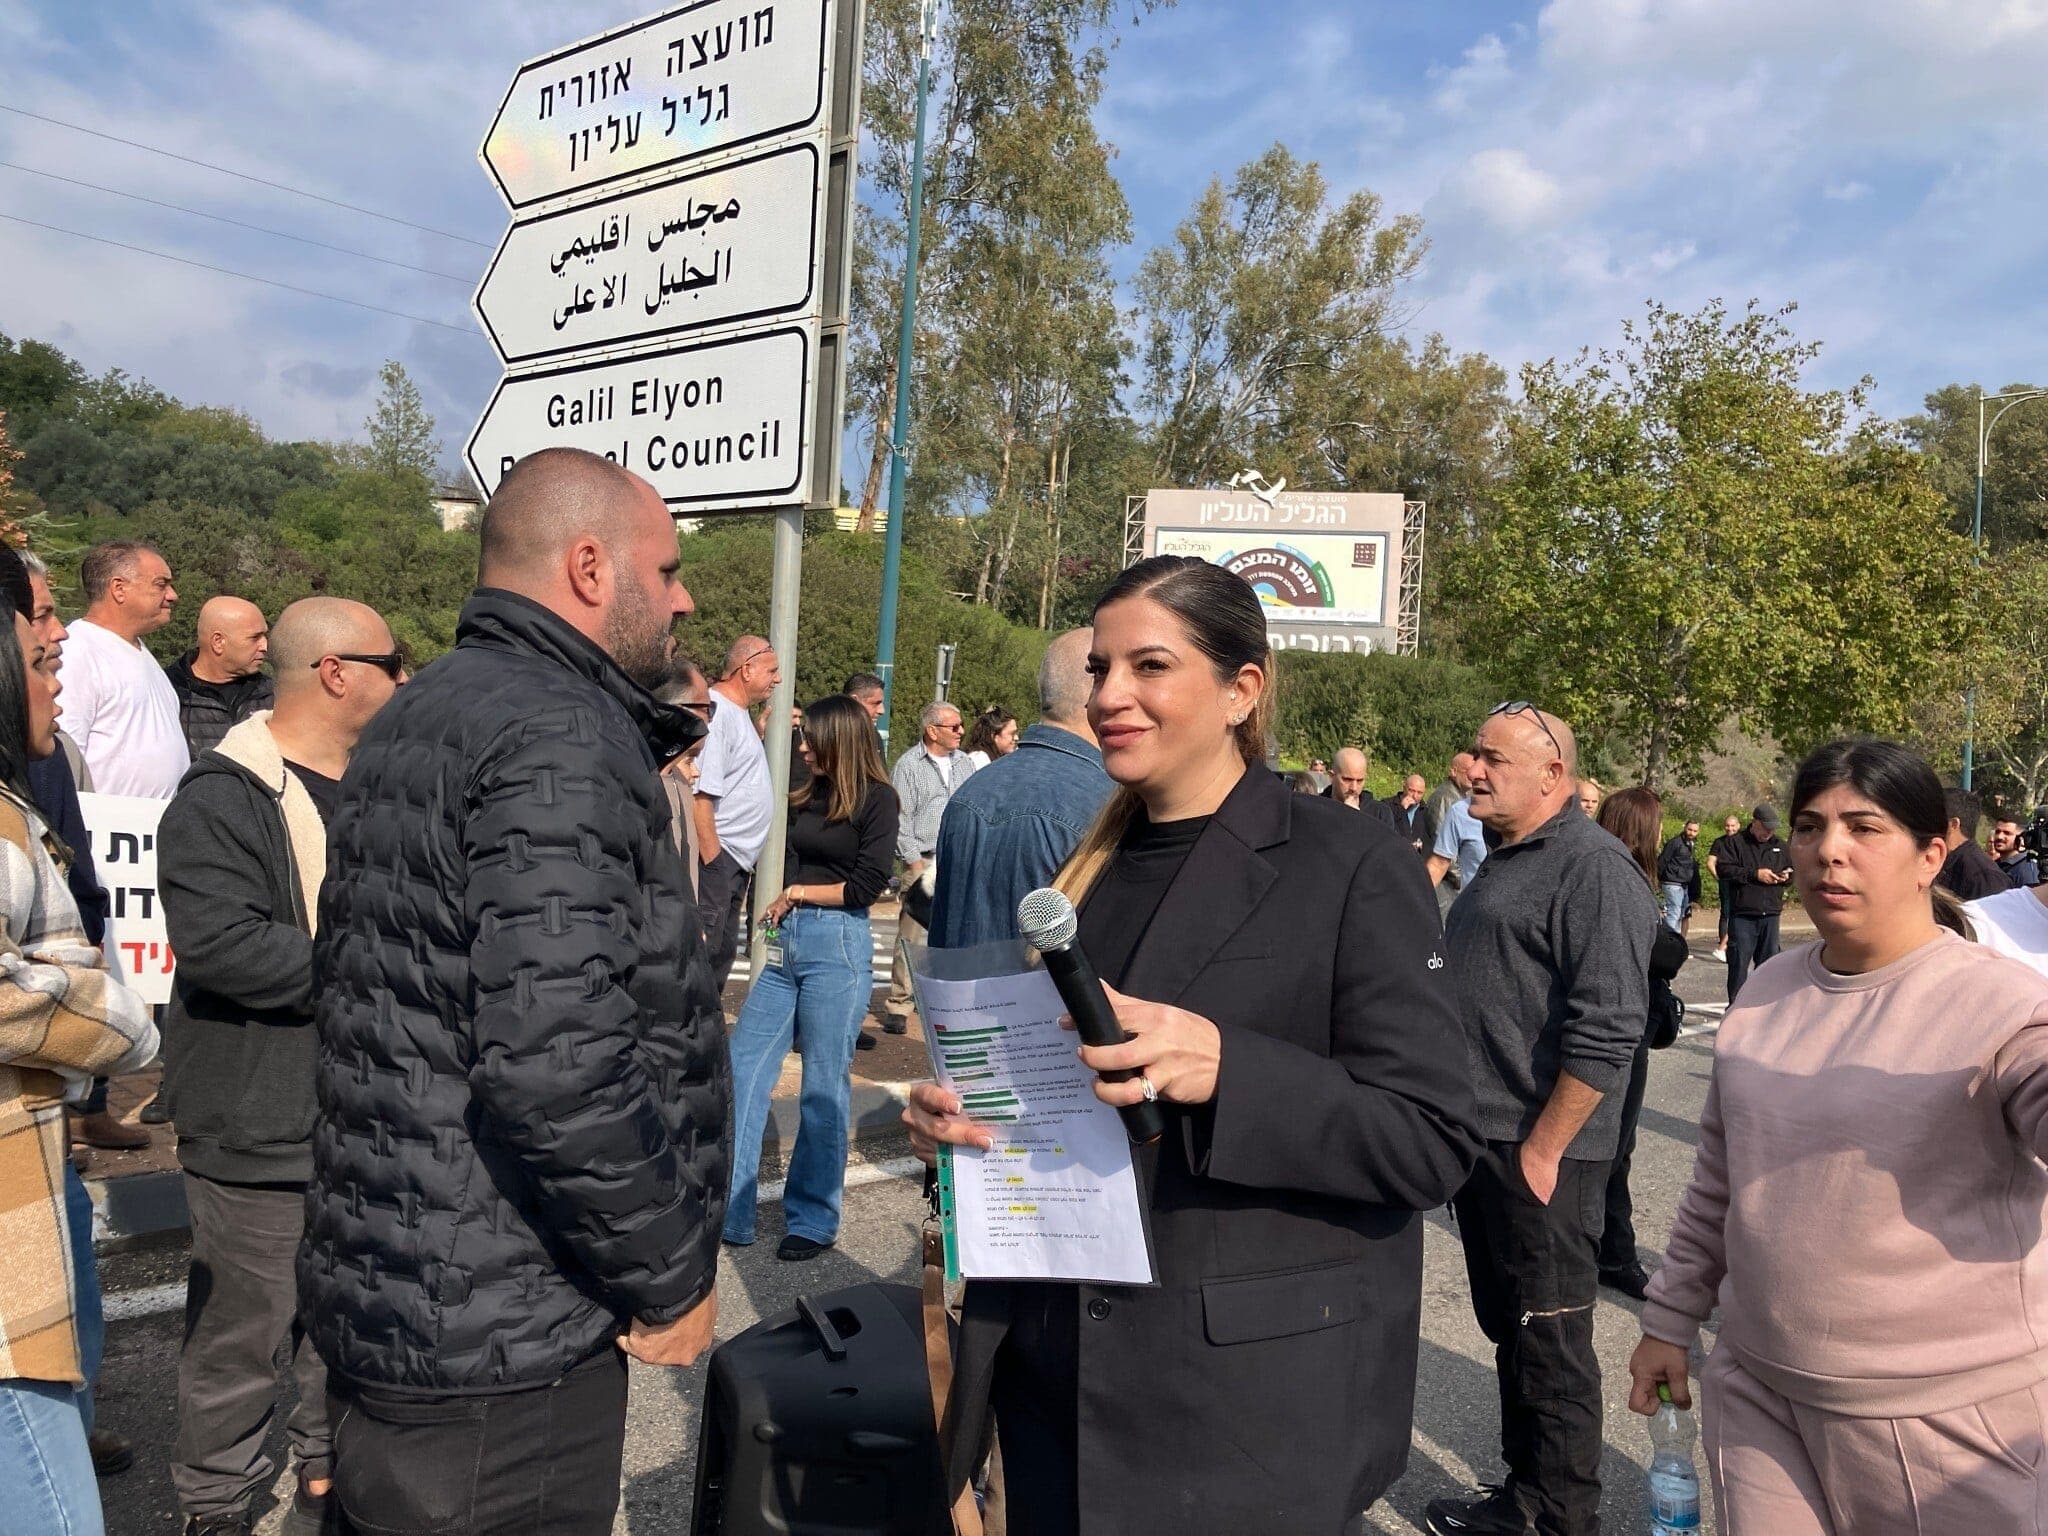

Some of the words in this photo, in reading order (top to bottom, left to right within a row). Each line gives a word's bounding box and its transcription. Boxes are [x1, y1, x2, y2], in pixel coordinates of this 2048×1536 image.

[667, 6, 774, 77] מועצה
[539, 57, 631, 120] אזורית
[662, 83, 730, 136] גליל
[569, 111, 641, 171] עליון
[550, 213, 630, 276] اقليمي
[648, 196, 741, 252] مجلس
[645, 246, 732, 316] الجليل
[547, 386, 614, 428] Galil
[631, 375, 723, 421] Elyon
[647, 420, 780, 471] Council
[1200, 500, 1270, 525] העליון
[1278, 501, 1347, 524] הגליל
